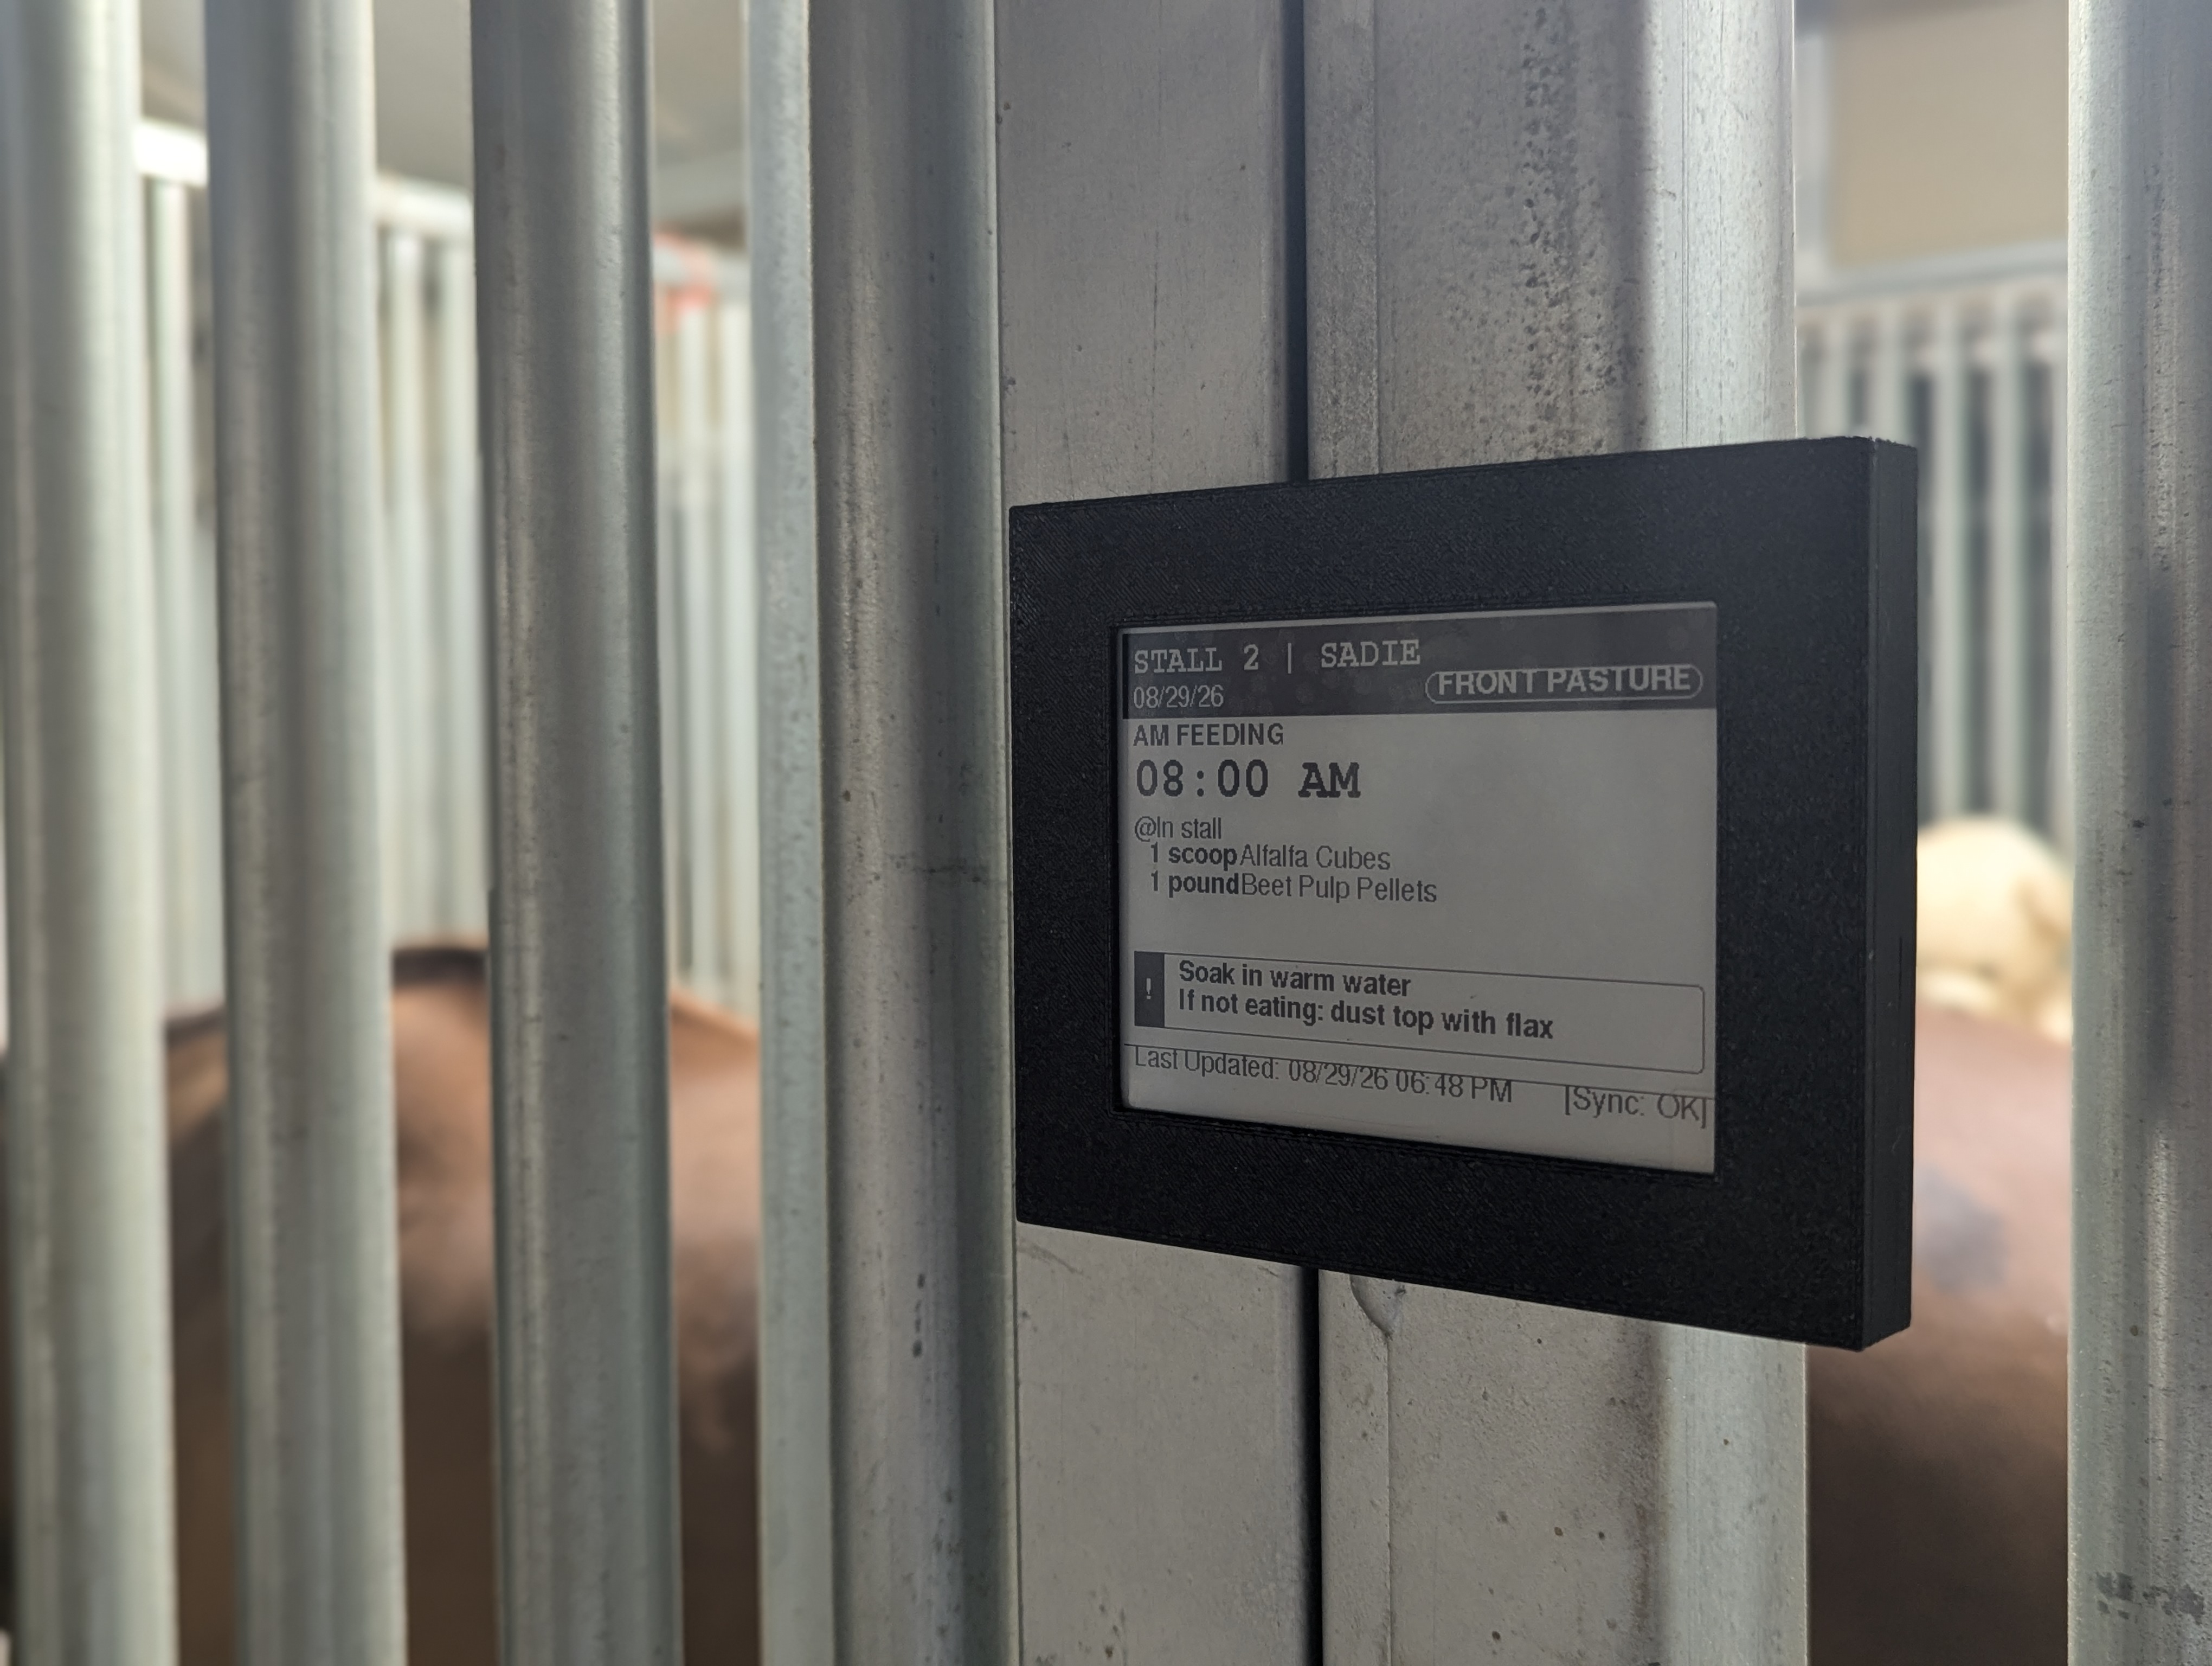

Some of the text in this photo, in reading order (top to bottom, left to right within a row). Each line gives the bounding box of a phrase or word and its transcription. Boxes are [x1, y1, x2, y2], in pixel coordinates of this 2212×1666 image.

[1134, 648, 1222, 674] STALL
[1244, 644, 1259, 670] 2
[1321, 639, 1421, 668] SADIE
[1133, 684, 1224, 708] 08/29/26
[1439, 665, 1691, 695] FRONT PASTURE
[1133, 722, 1284, 746] AM FEEDING
[1136, 759, 1361, 798] 08:00 AM
[1181, 817, 1221, 839] stall
[1150, 842, 1159, 863] 1
[1240, 844, 1308, 868] Alfalfa
[1316, 845, 1391, 870] Cubes
[1150, 871, 1159, 892] 1
[1242, 873, 1292, 897] Beet
[1300, 875, 1350, 904] Pulp
[1357, 877, 1437, 903] Pellets
[1179, 959, 1411, 997] Soak in warm water
[1179, 988, 1553, 1039] If not eating: dust top with flax
[1135, 1046, 1512, 1102] Last Updated: 08/29/26 06:48 PM
